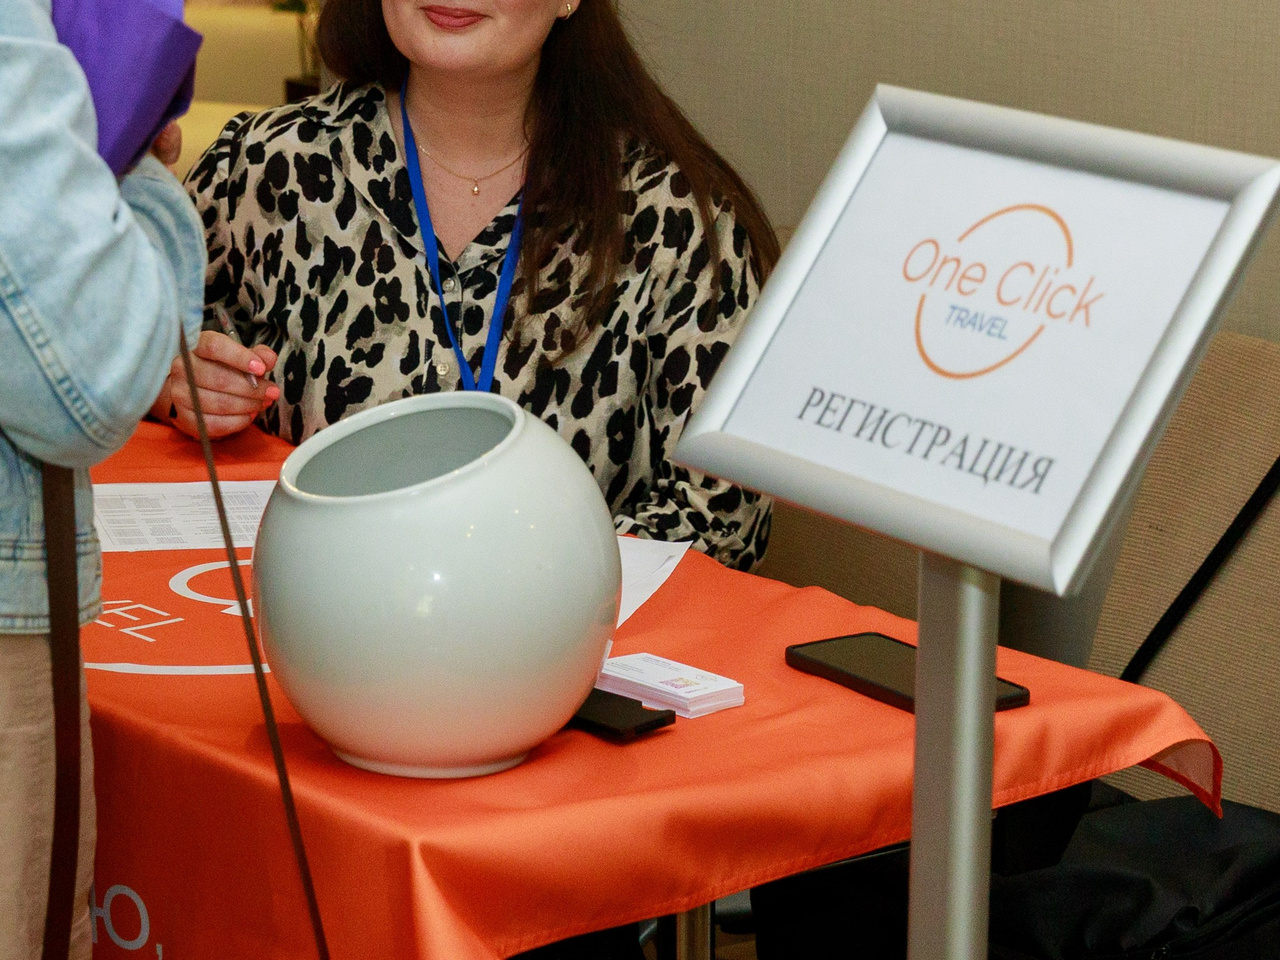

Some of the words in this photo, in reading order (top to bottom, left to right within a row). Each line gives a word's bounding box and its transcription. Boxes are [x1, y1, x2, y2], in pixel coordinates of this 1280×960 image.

[902, 238, 987, 297] One
[996, 260, 1106, 328] Click
[945, 303, 1009, 341] TRAVEL
[795, 386, 1055, 495] РЕГИСТРАЦИЯ
